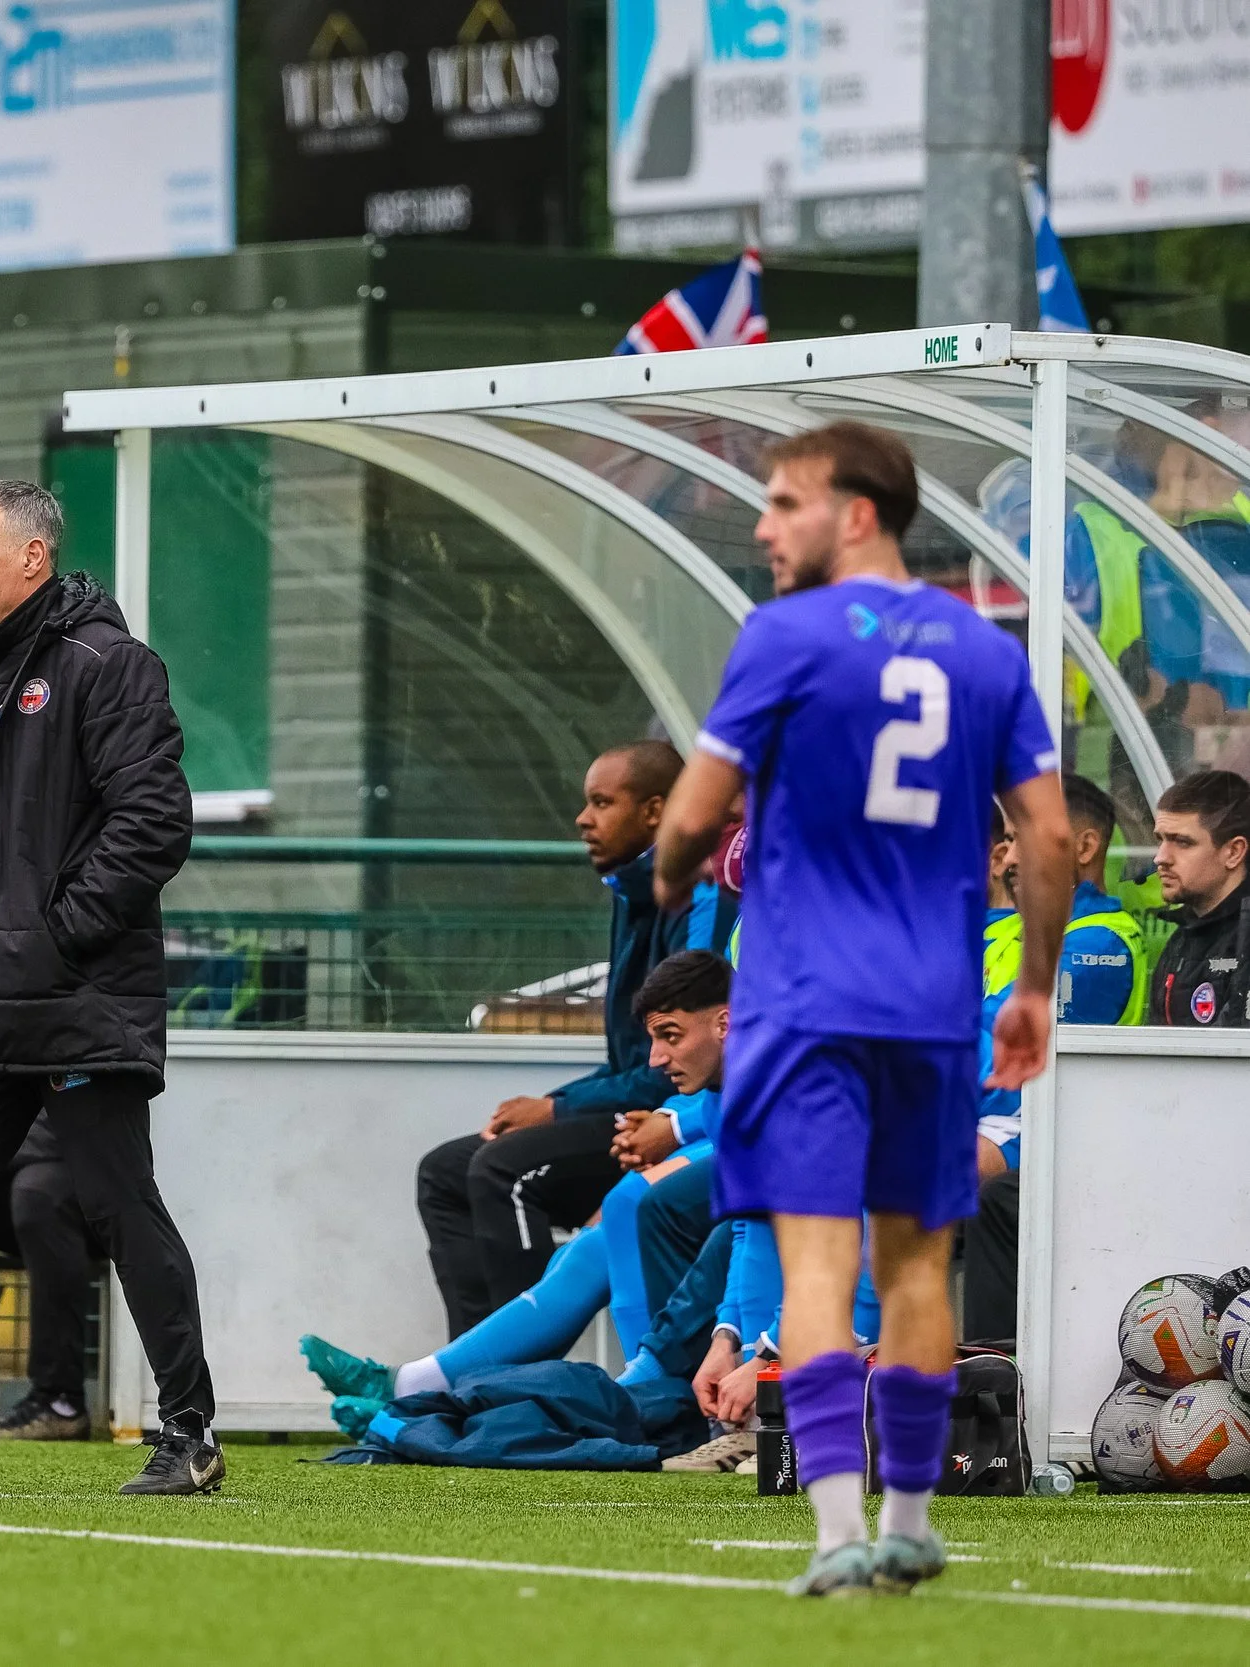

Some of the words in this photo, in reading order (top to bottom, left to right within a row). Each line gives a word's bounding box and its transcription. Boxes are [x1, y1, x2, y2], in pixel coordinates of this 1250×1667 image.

[925, 336, 958, 364] HOME
[864, 655, 949, 828] 2
[780, 1434, 792, 1478] precision
